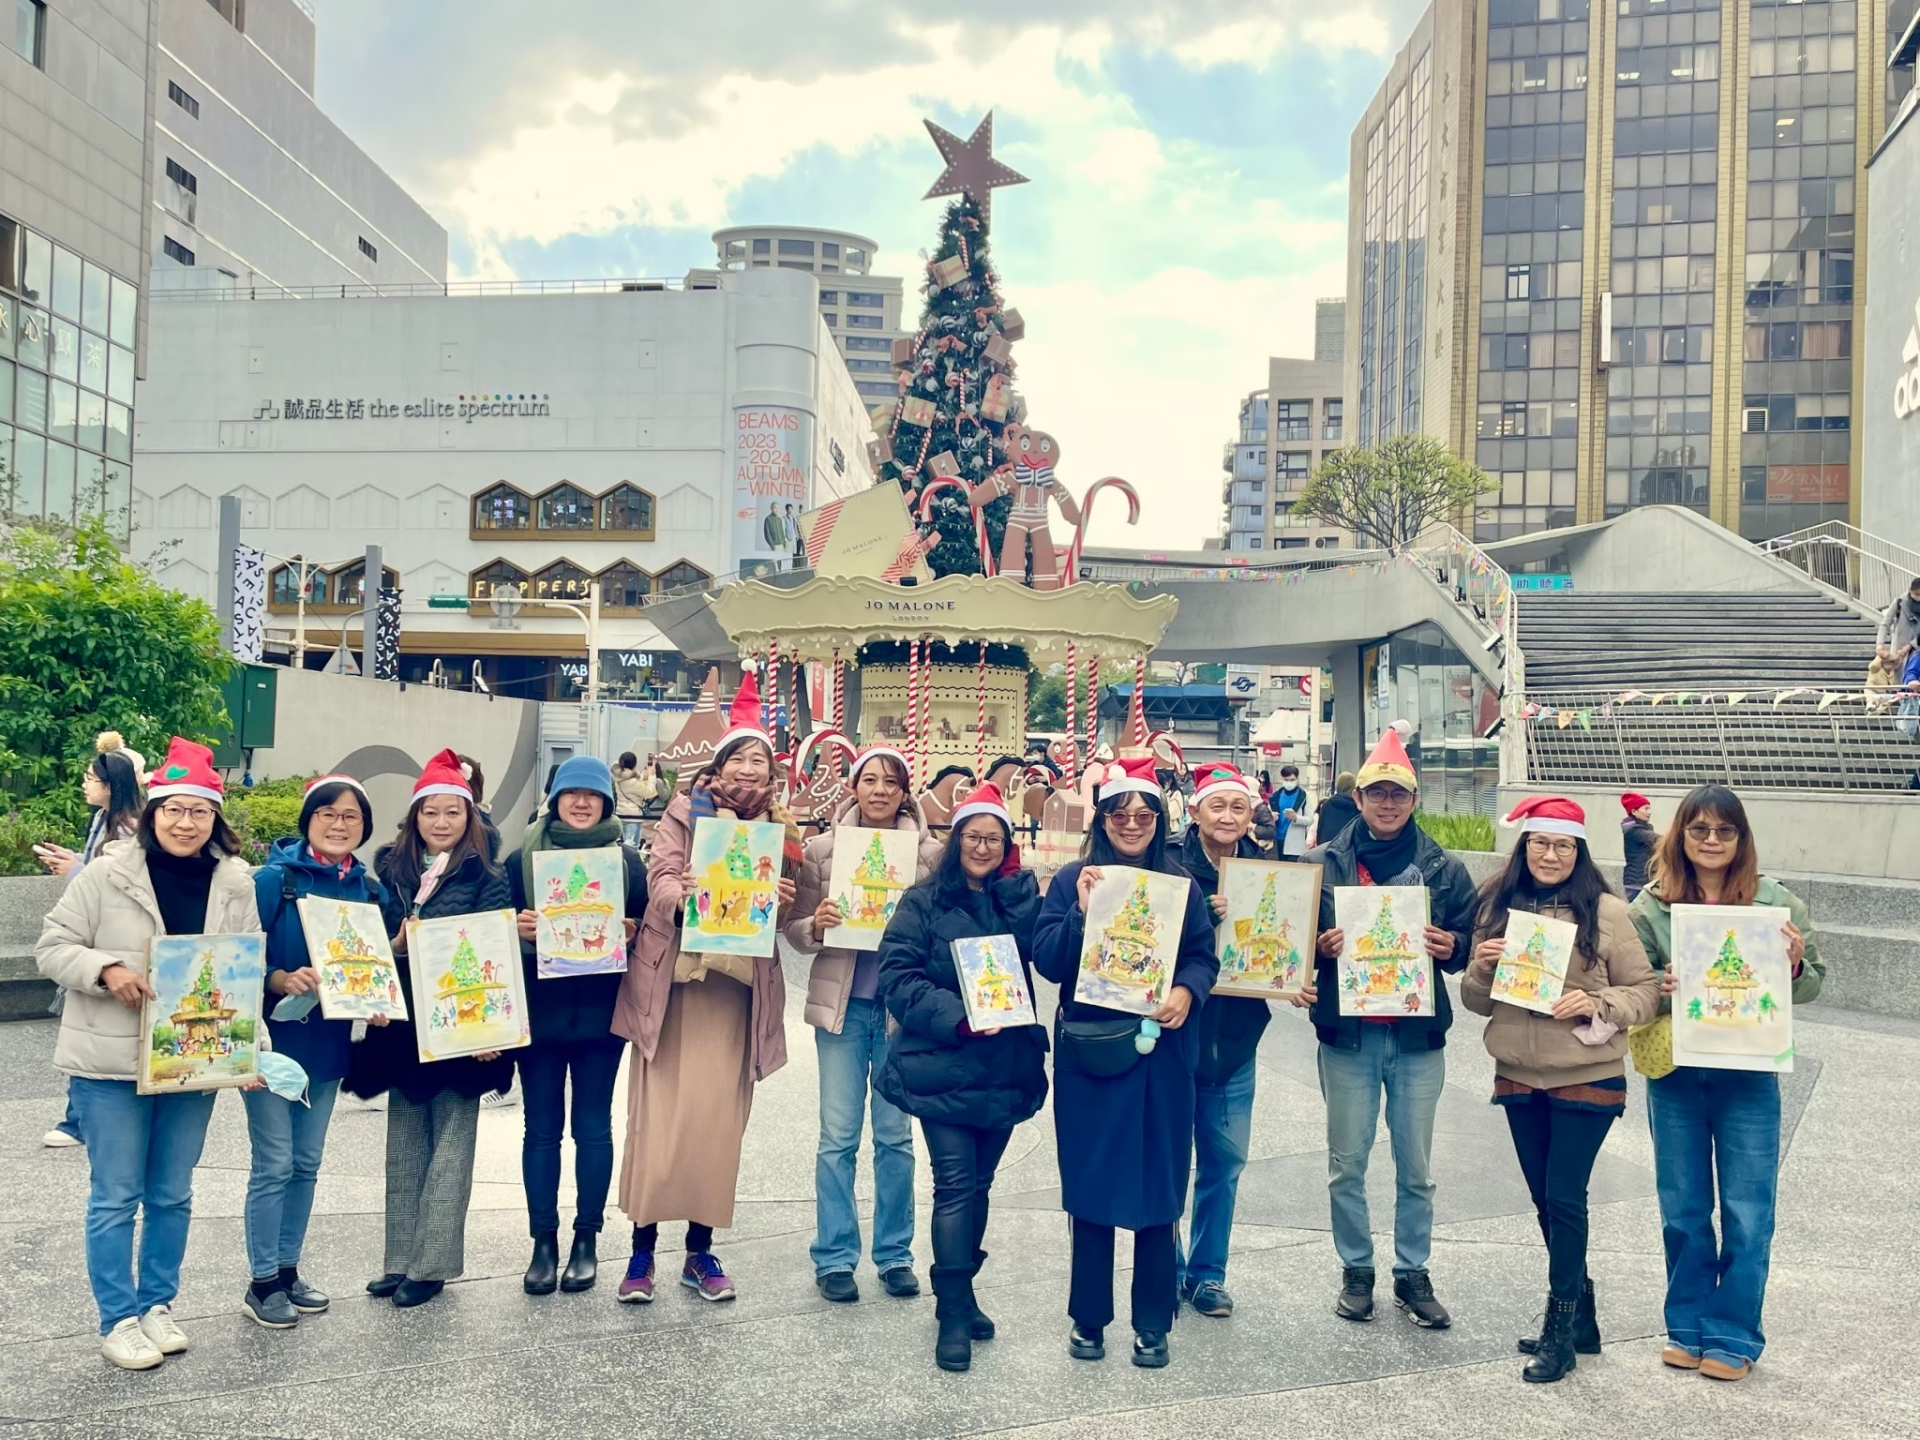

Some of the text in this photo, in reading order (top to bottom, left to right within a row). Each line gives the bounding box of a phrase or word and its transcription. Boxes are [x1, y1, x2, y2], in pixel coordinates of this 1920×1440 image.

[284, 397, 550, 424] 誠品生活 the eslite spectrum
[738, 412, 799, 431] BEAMS
[738, 433, 777, 449] 2023
[738, 465, 805, 484] AUTUMN
[475, 578, 592, 598] FPPER'S
[865, 600, 956, 611] JO MALONE
[619, 653, 653, 667] YABI
[560, 663, 588, 677] YAB
